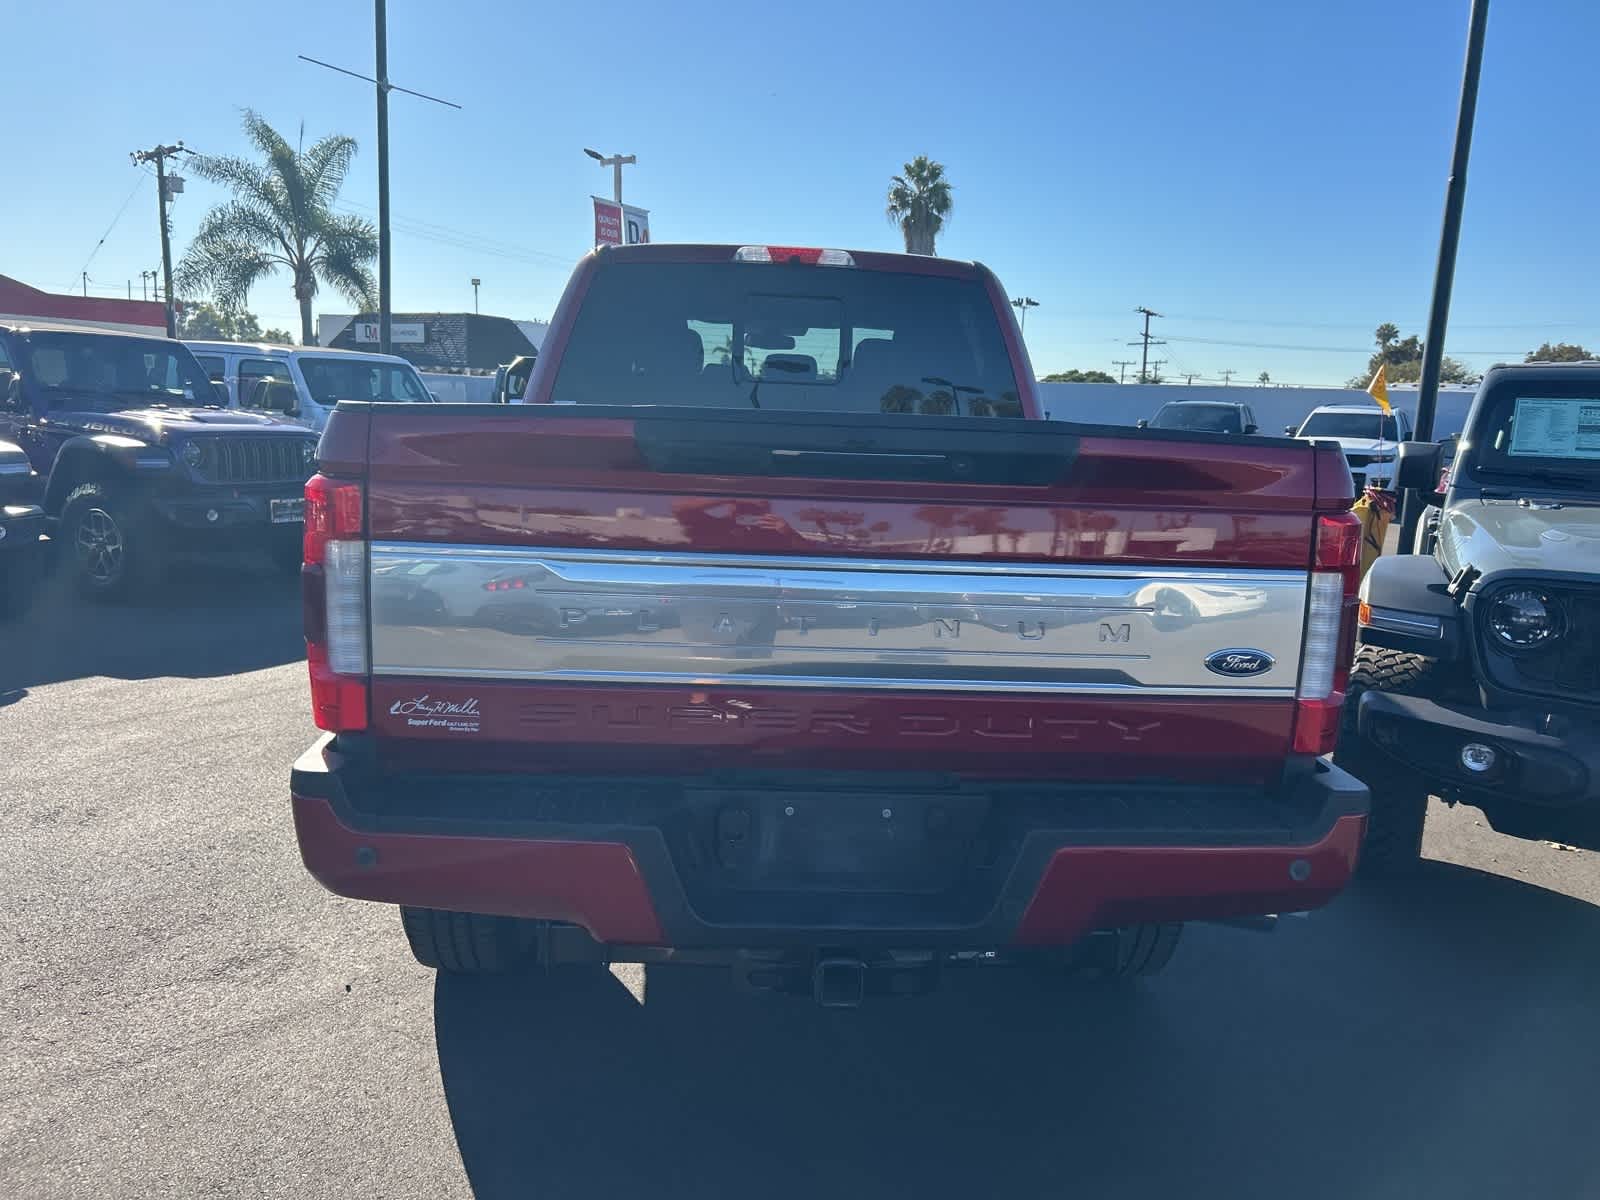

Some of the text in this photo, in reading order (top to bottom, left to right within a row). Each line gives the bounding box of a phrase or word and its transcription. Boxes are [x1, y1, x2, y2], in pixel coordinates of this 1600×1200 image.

[559, 607, 1131, 643] PLATINUM
[1222, 654, 1261, 669] Ford
[428, 719, 447, 727] Ford
[899, 712, 1161, 741] DUTY
